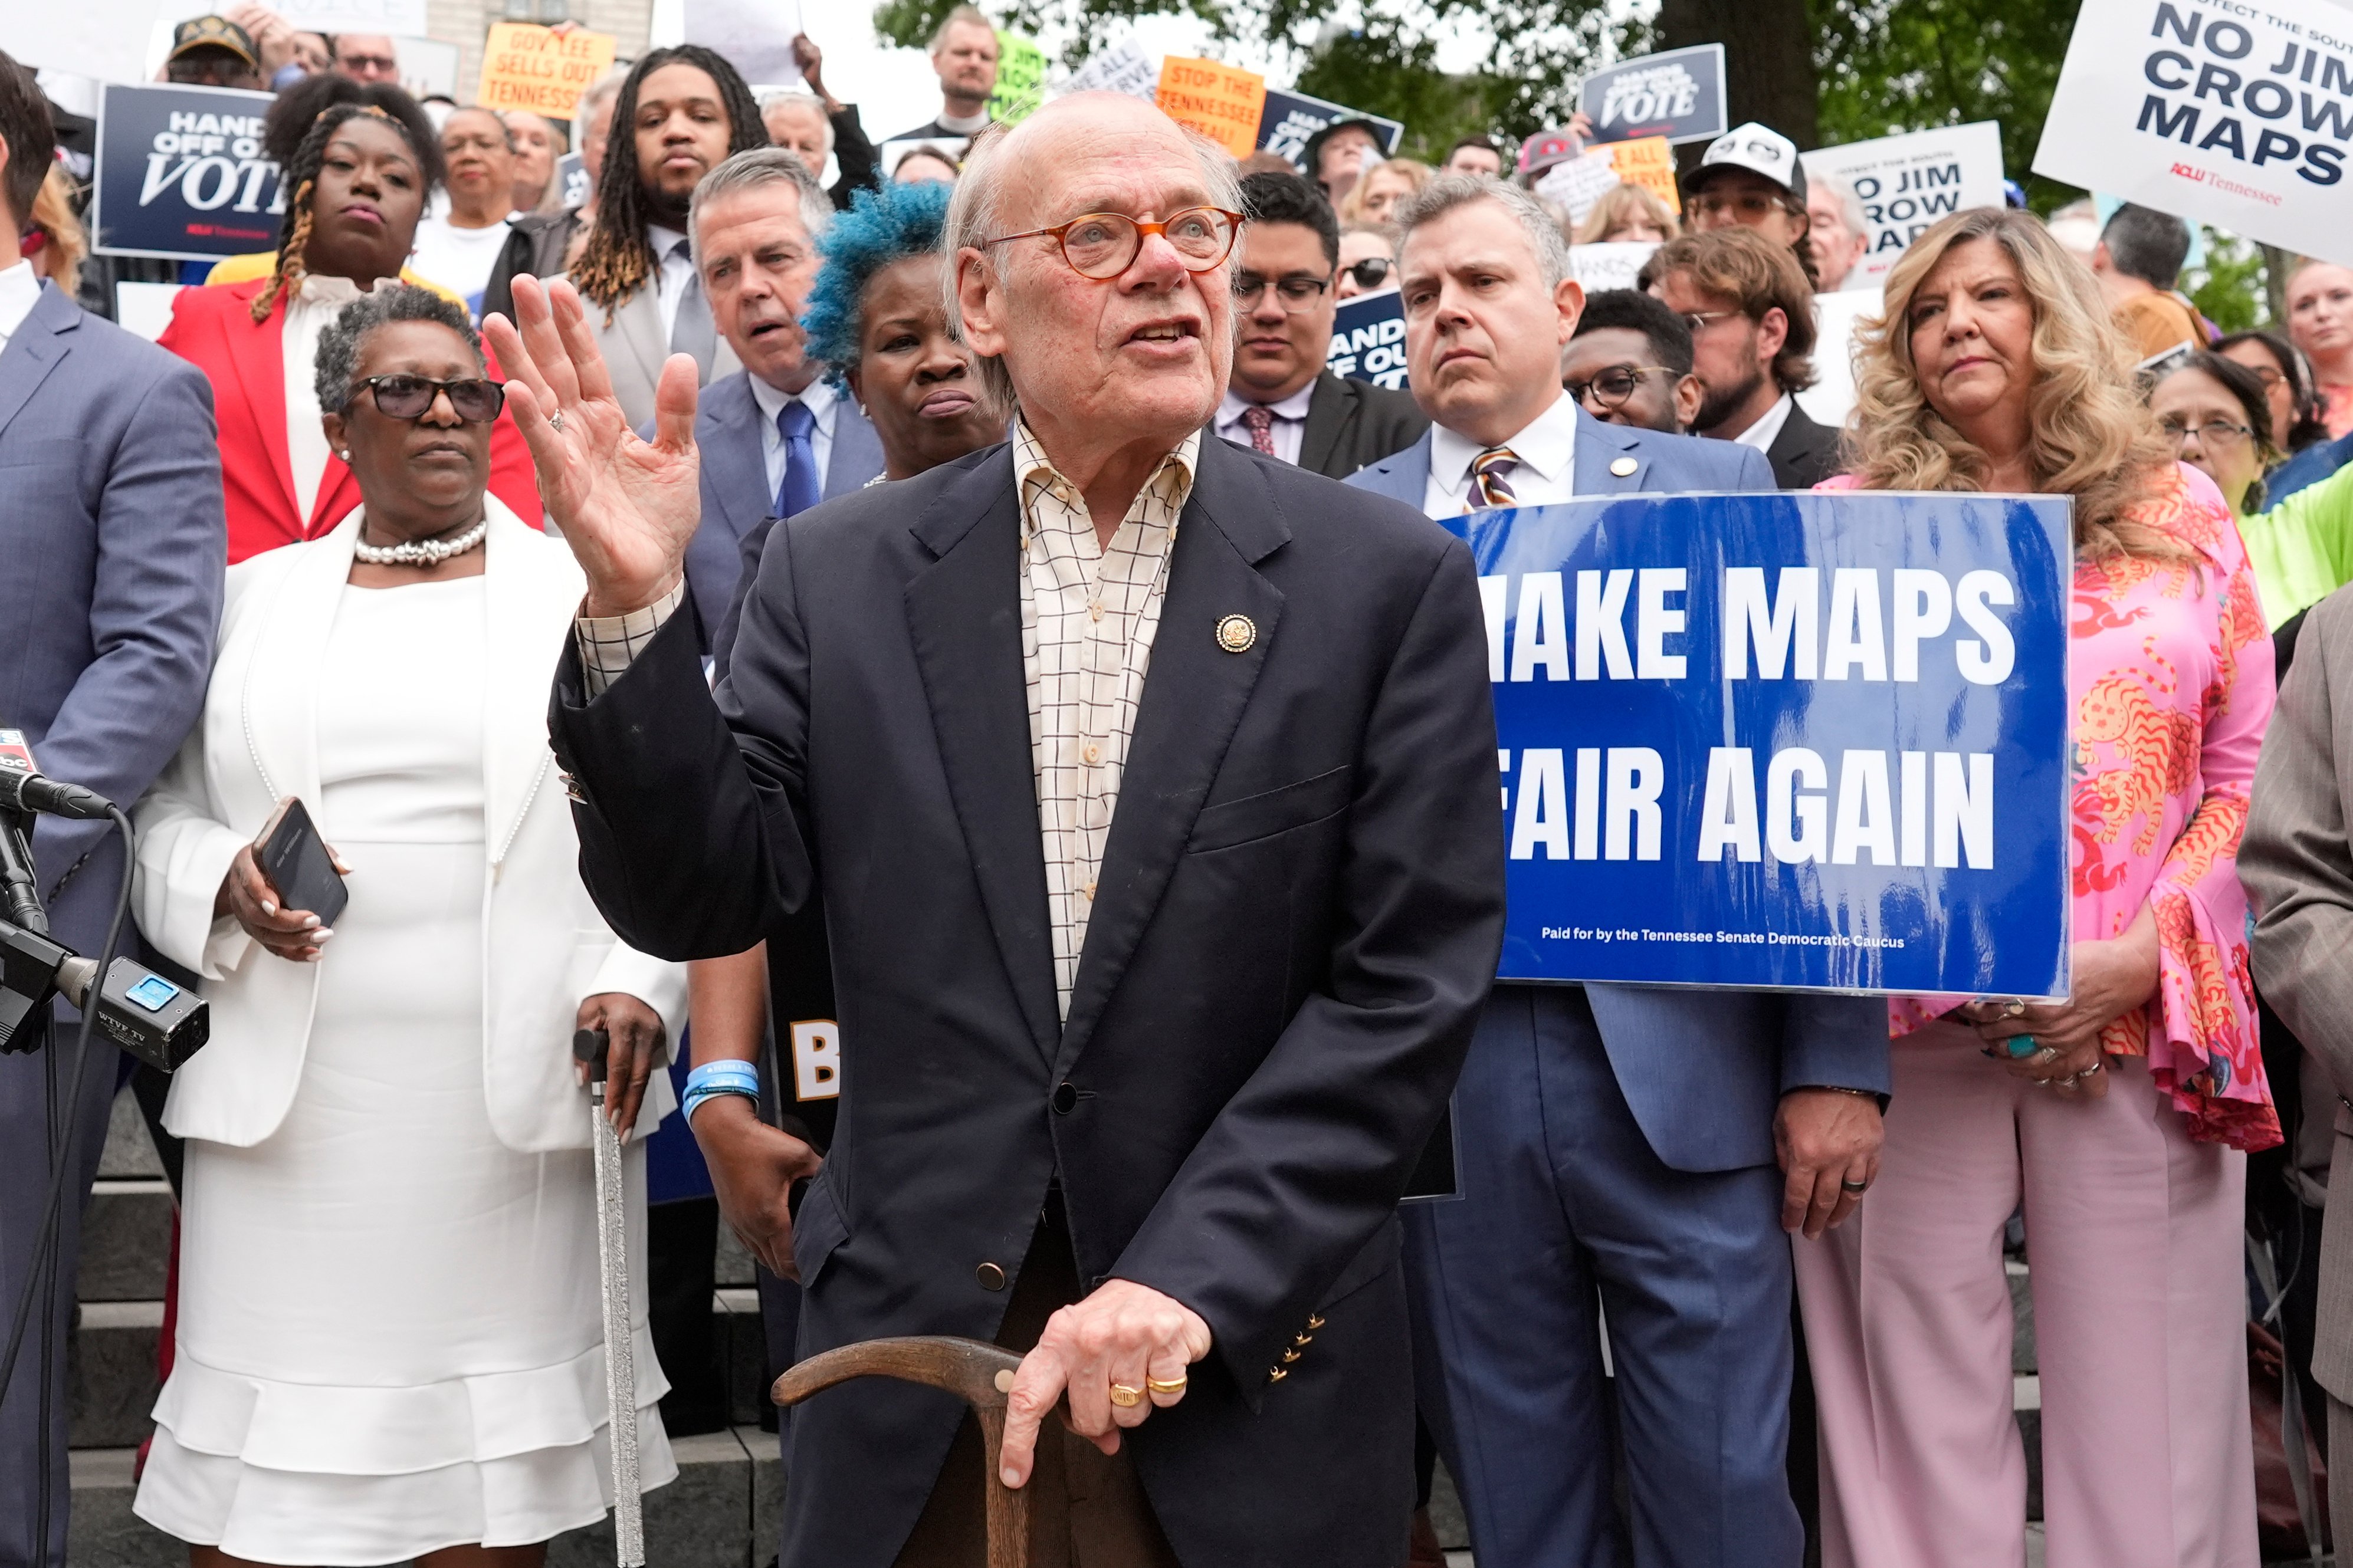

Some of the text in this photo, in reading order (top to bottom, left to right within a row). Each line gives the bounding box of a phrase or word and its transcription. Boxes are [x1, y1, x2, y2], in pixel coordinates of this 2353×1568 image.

[2151, 1, 2253, 60] NO
[2266, 14, 2301, 34] THE
[2308, 30, 2353, 54] SOUT
[495, 53, 599, 86] SELLS OUT
[1171, 66, 1217, 88] STOP
[1223, 75, 1255, 100] THE
[488, 78, 582, 111] TENNESS
[1600, 84, 1700, 129] VOTE
[2144, 50, 2353, 142] CROW
[169, 110, 269, 139] HAND
[2137, 94, 2347, 186] MAPS
[152, 131, 226, 157] OFF
[1630, 145, 1659, 165] ALL
[1853, 177, 1881, 200] O
[1896, 162, 1961, 193] JIM
[2170, 162, 2283, 206] ACLU Tennessee
[1865, 190, 1960, 224] ROW
[1865, 223, 1932, 255] AP
[1327, 317, 1407, 360] AND
[1363, 342, 1408, 374] OU
[1724, 567, 2016, 686] MAPS
[0, 755, 28, 768] bc
[1497, 747, 1994, 870] AIR AGAIN
[1541, 926, 1905, 949] Paid for by the Tennessee Senate Democratic Caucus
[97, 1010, 129, 1033] WTVF
[131, 1023, 146, 1042] TV
